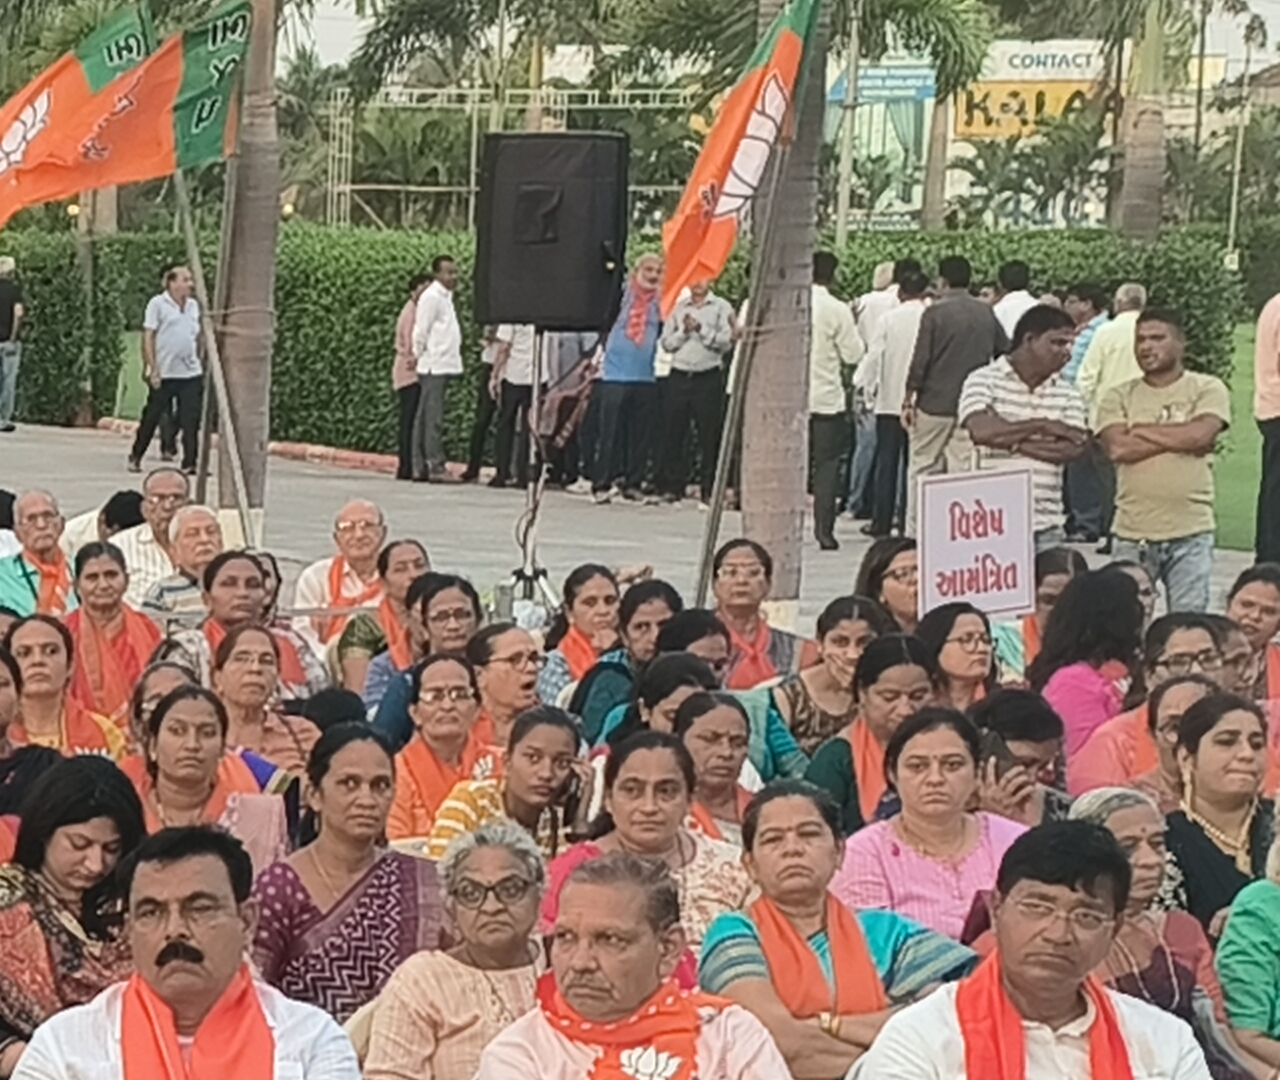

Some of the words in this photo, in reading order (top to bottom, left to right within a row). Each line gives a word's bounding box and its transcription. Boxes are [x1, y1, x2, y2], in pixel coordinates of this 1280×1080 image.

[1009, 53, 1092, 69] CONTACT
[949, 498, 1005, 542] વિશેષ
[935, 552, 1018, 598] આમંત્રિત
